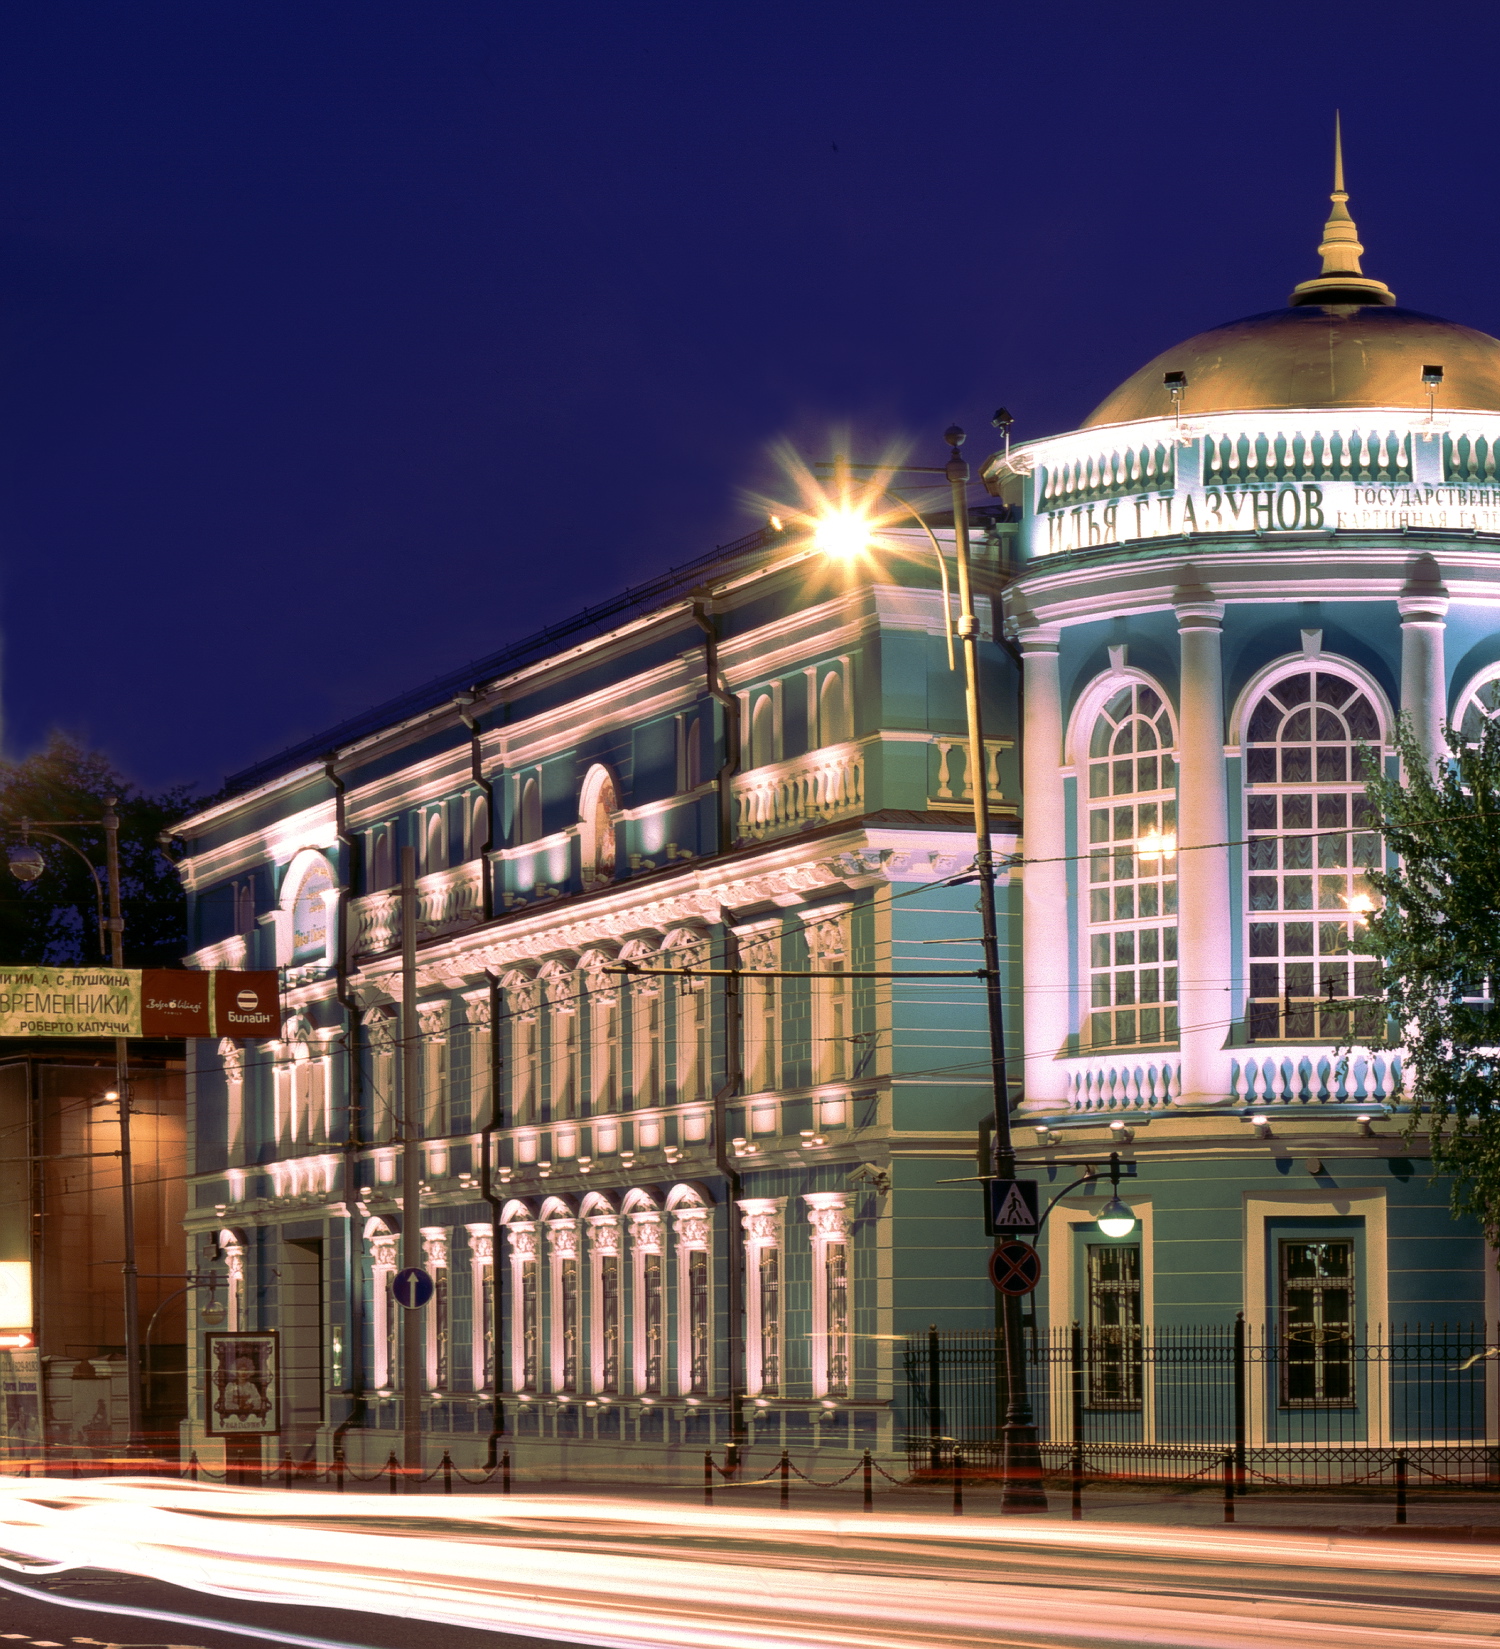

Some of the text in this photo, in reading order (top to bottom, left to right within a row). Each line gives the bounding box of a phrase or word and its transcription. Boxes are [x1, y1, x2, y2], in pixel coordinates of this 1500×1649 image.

[1047, 488, 1325, 552] ИЛЬЯ ГЛАЗУНОВ
[1336, 510, 1448, 528] КАРТИННАЯ
[15, 974, 37, 986] ИМ.
[41, 975, 53, 987] А.
[56, 975, 69, 988] С.
[72, 975, 130, 987] ПУШКИНА
[0, 993, 128, 1015] ВРЕМЕННИКИ
[228, 1011, 271, 1023] Билайн
[20, 1021, 130, 1033] РОБЕРТО КАПУЧЧИ
